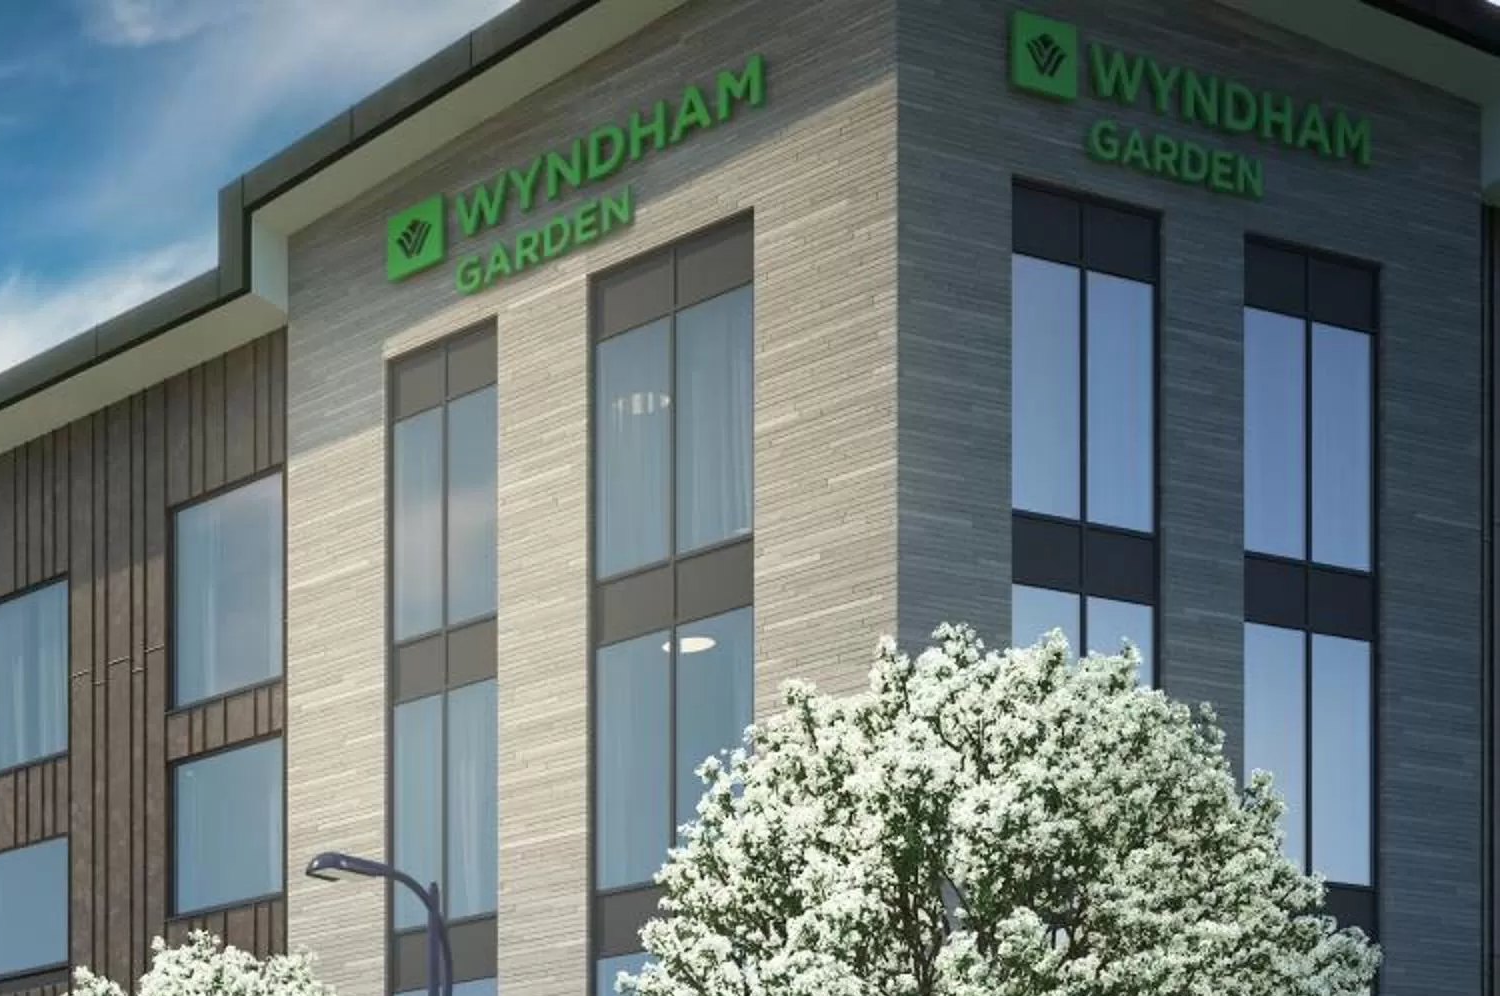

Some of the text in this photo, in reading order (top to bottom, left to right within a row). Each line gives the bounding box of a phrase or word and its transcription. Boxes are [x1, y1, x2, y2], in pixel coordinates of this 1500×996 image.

[455, 54, 766, 237] WYNDHAM
[1088, 42, 1372, 166] WYNDHAM
[1089, 119, 1263, 198] GARDEN
[455, 187, 634, 294] GARDEN
